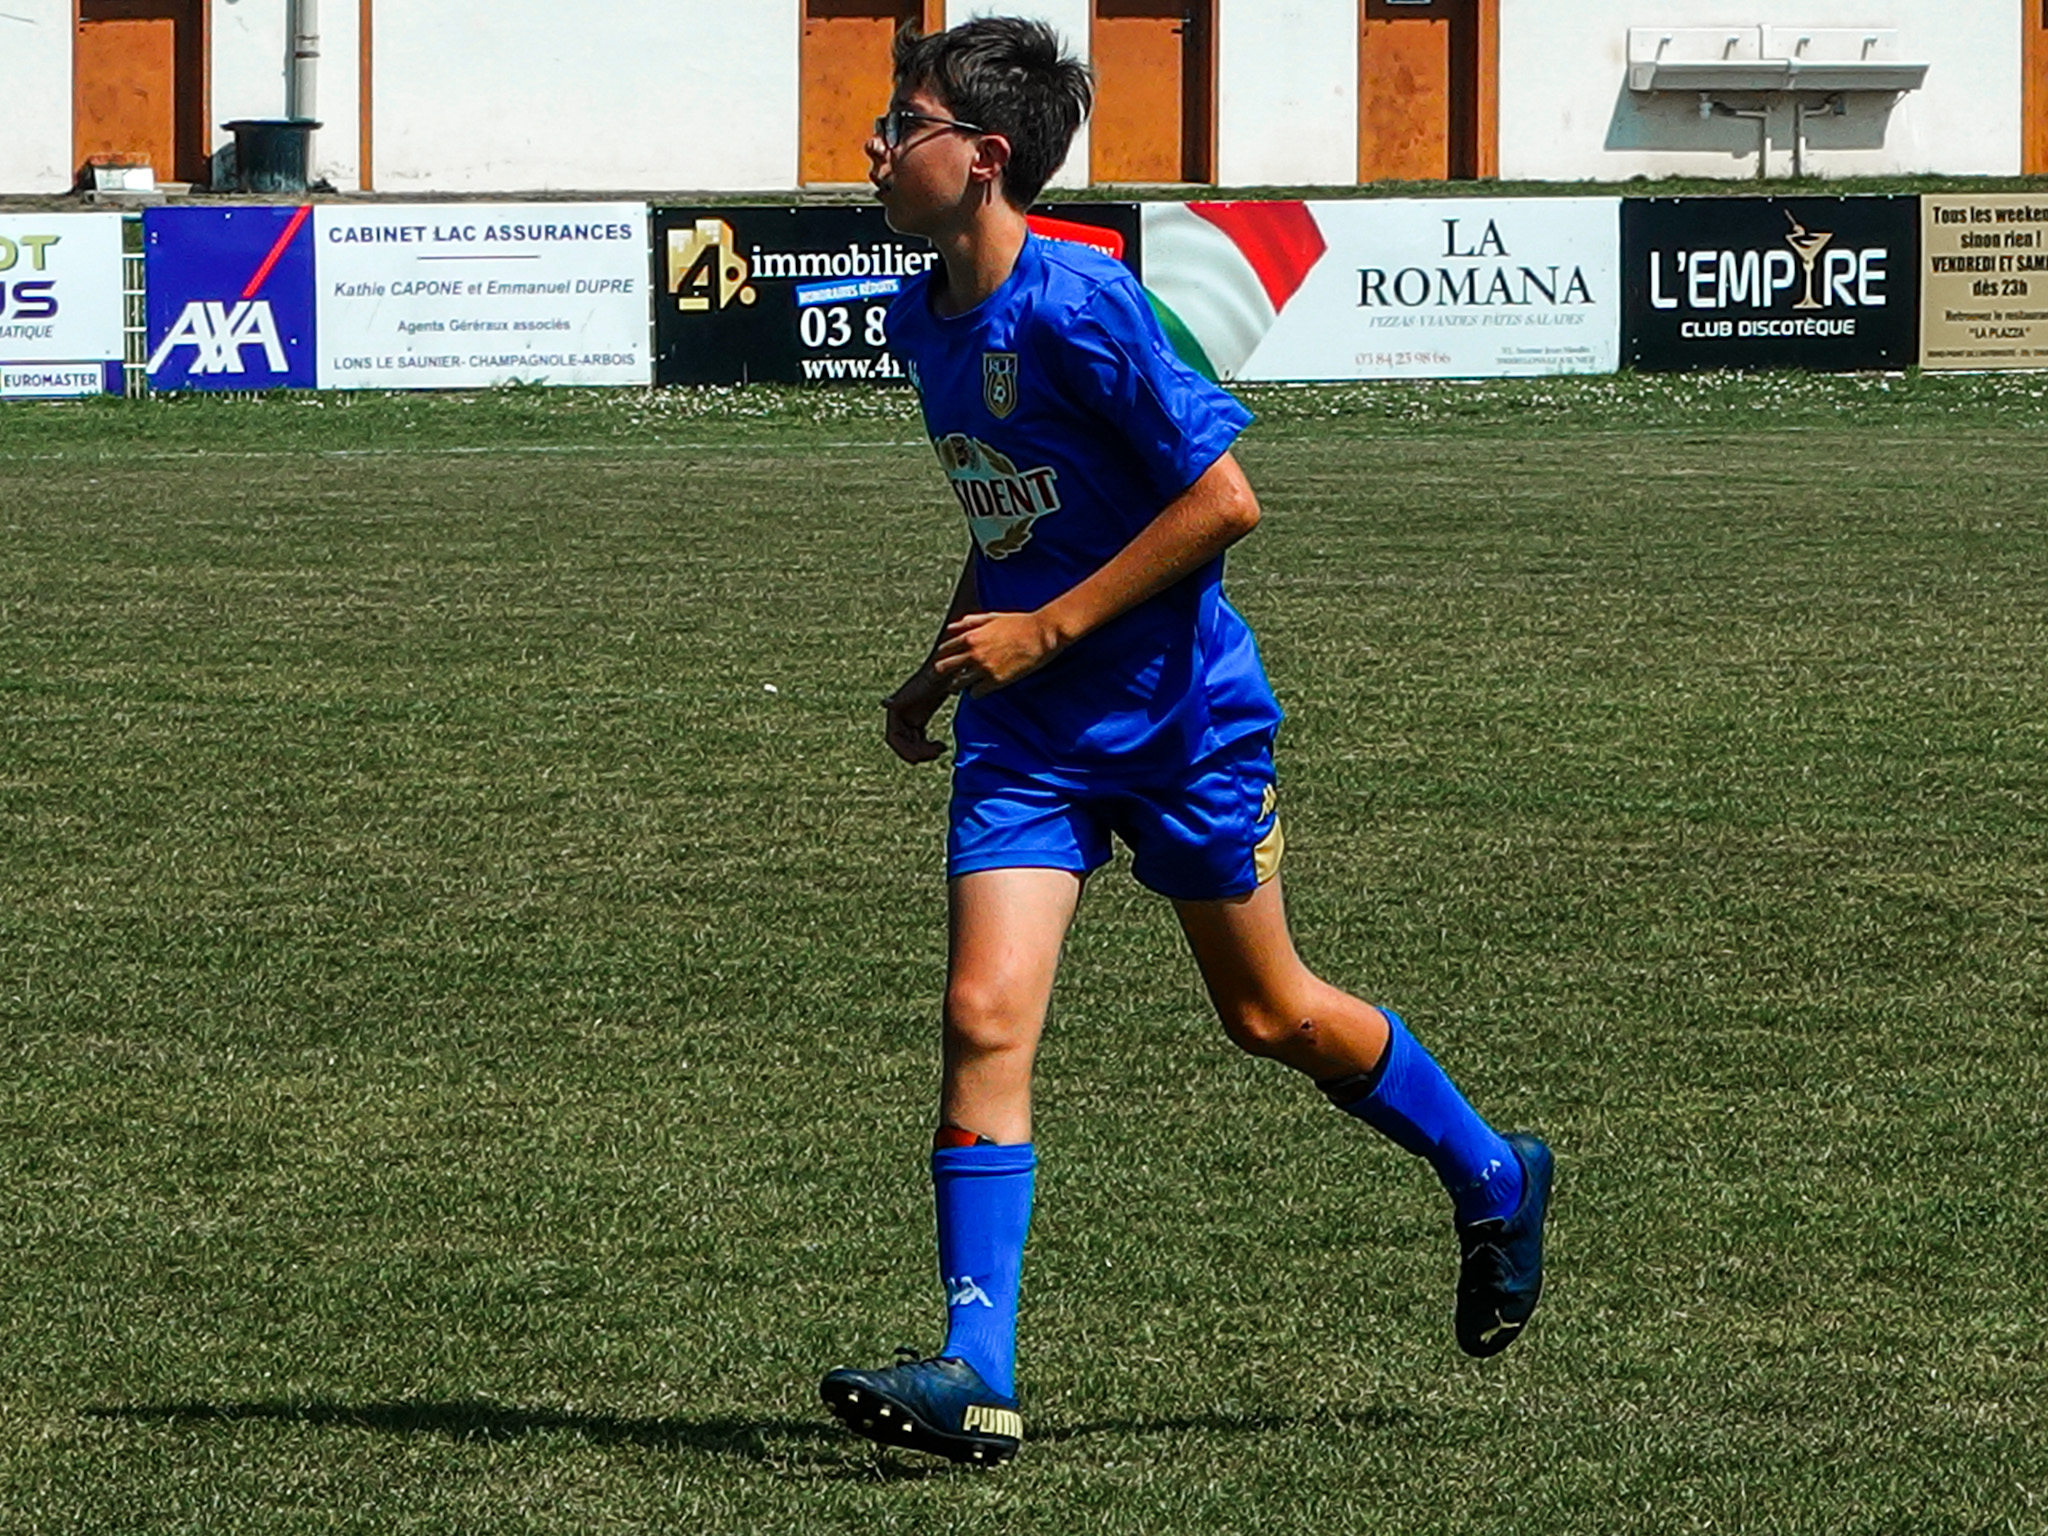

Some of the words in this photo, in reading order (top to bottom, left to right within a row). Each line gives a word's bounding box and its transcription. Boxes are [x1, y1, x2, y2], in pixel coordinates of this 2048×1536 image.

[1932, 206, 1968, 224] Tous
[1970, 206, 1992, 223] les
[328, 226, 427, 243] CABINET
[434, 225, 477, 242] LAC
[483, 223, 633, 241] ASSURANCES
[1441, 217, 1511, 258] LA
[1961, 231, 2001, 248] sinon
[2004, 230, 2033, 248] rien
[2036, 230, 2042, 248] !
[751, 244, 939, 278] immobilier
[1931, 256, 1996, 273] VENDREDI
[1999, 255, 2013, 272] ET
[2017, 254, 2048, 272] SAM
[334, 282, 386, 297] Kathie
[391, 280, 463, 296] CAPONE
[467, 282, 483, 295] et
[487, 280, 571, 295] Emmanuel
[1356, 265, 1596, 307] ROMANA
[1973, 279, 1998, 296] dès
[2001, 279, 2028, 296] 23h
[0, 280, 58, 320] S
[0, 325, 54, 341] ATIQUE
[397, 320, 446, 335] Agents
[513, 317, 572, 331] associés
[800, 306, 852, 348] 03
[864, 305, 887, 346] 8
[1681, 320, 1733, 338] CLUB
[1738, 317, 1856, 337] DISCOTÈQUE
[146, 301, 289, 374] AXA
[333, 357, 372, 370] LONS
[376, 356, 394, 369] LE
[4, 372, 98, 388] EUROMASTER
